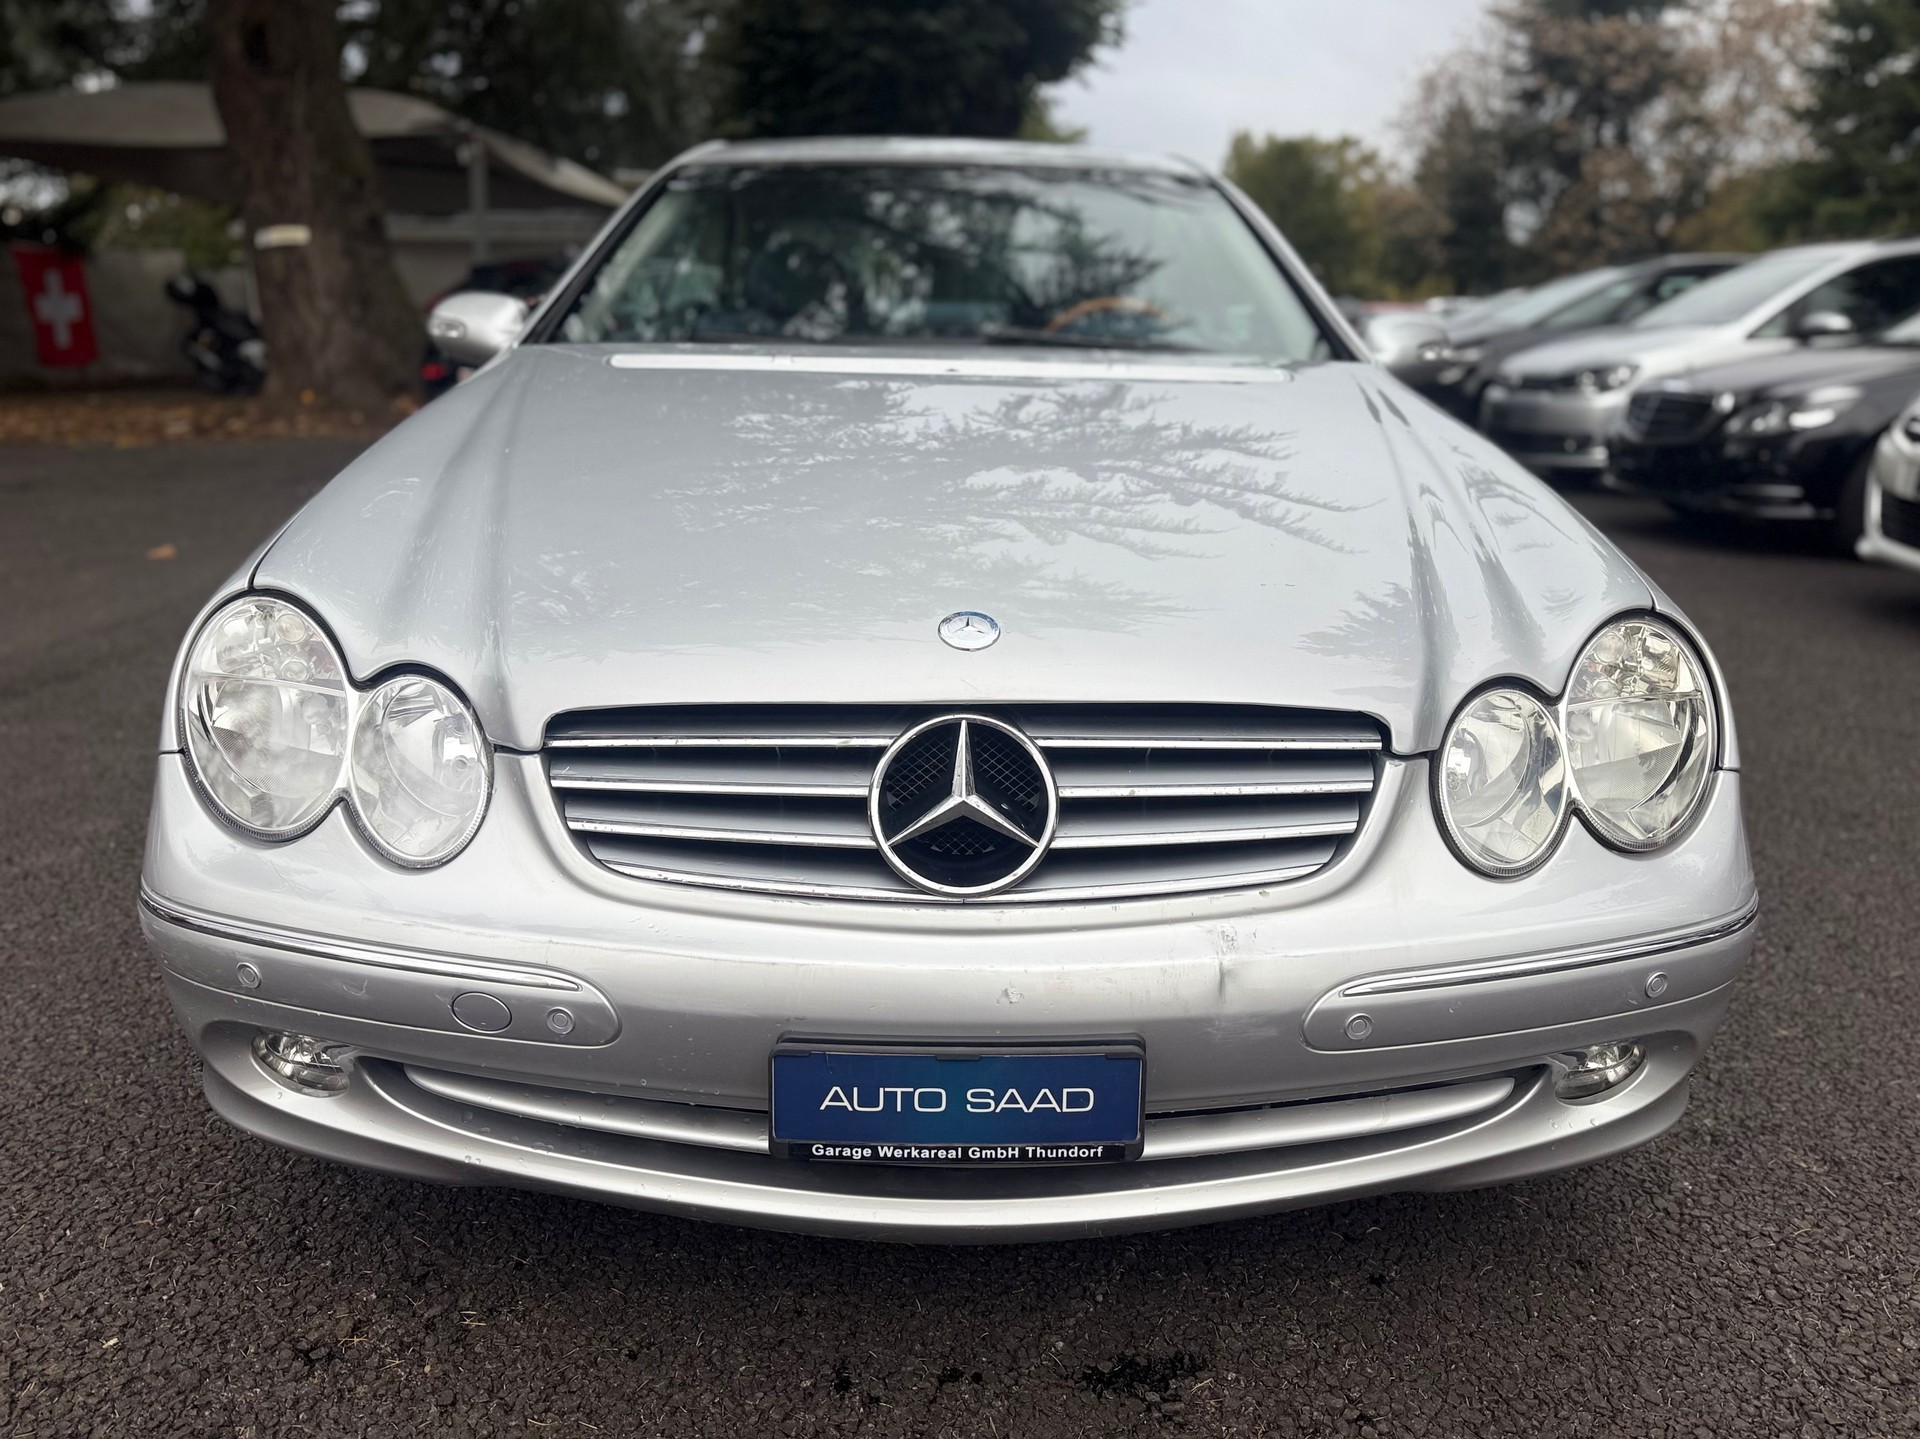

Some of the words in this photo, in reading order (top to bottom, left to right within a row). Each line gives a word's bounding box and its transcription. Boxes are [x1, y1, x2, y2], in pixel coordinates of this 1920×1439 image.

[819, 1086, 947, 1113] AUTO
[966, 1087, 1095, 1113] SAAD
[811, 1144, 872, 1160] Garage
[877, 1145, 962, 1159] Werkareal
[968, 1146, 1019, 1159] GmbH
[1026, 1145, 1104, 1159] Thundorf
